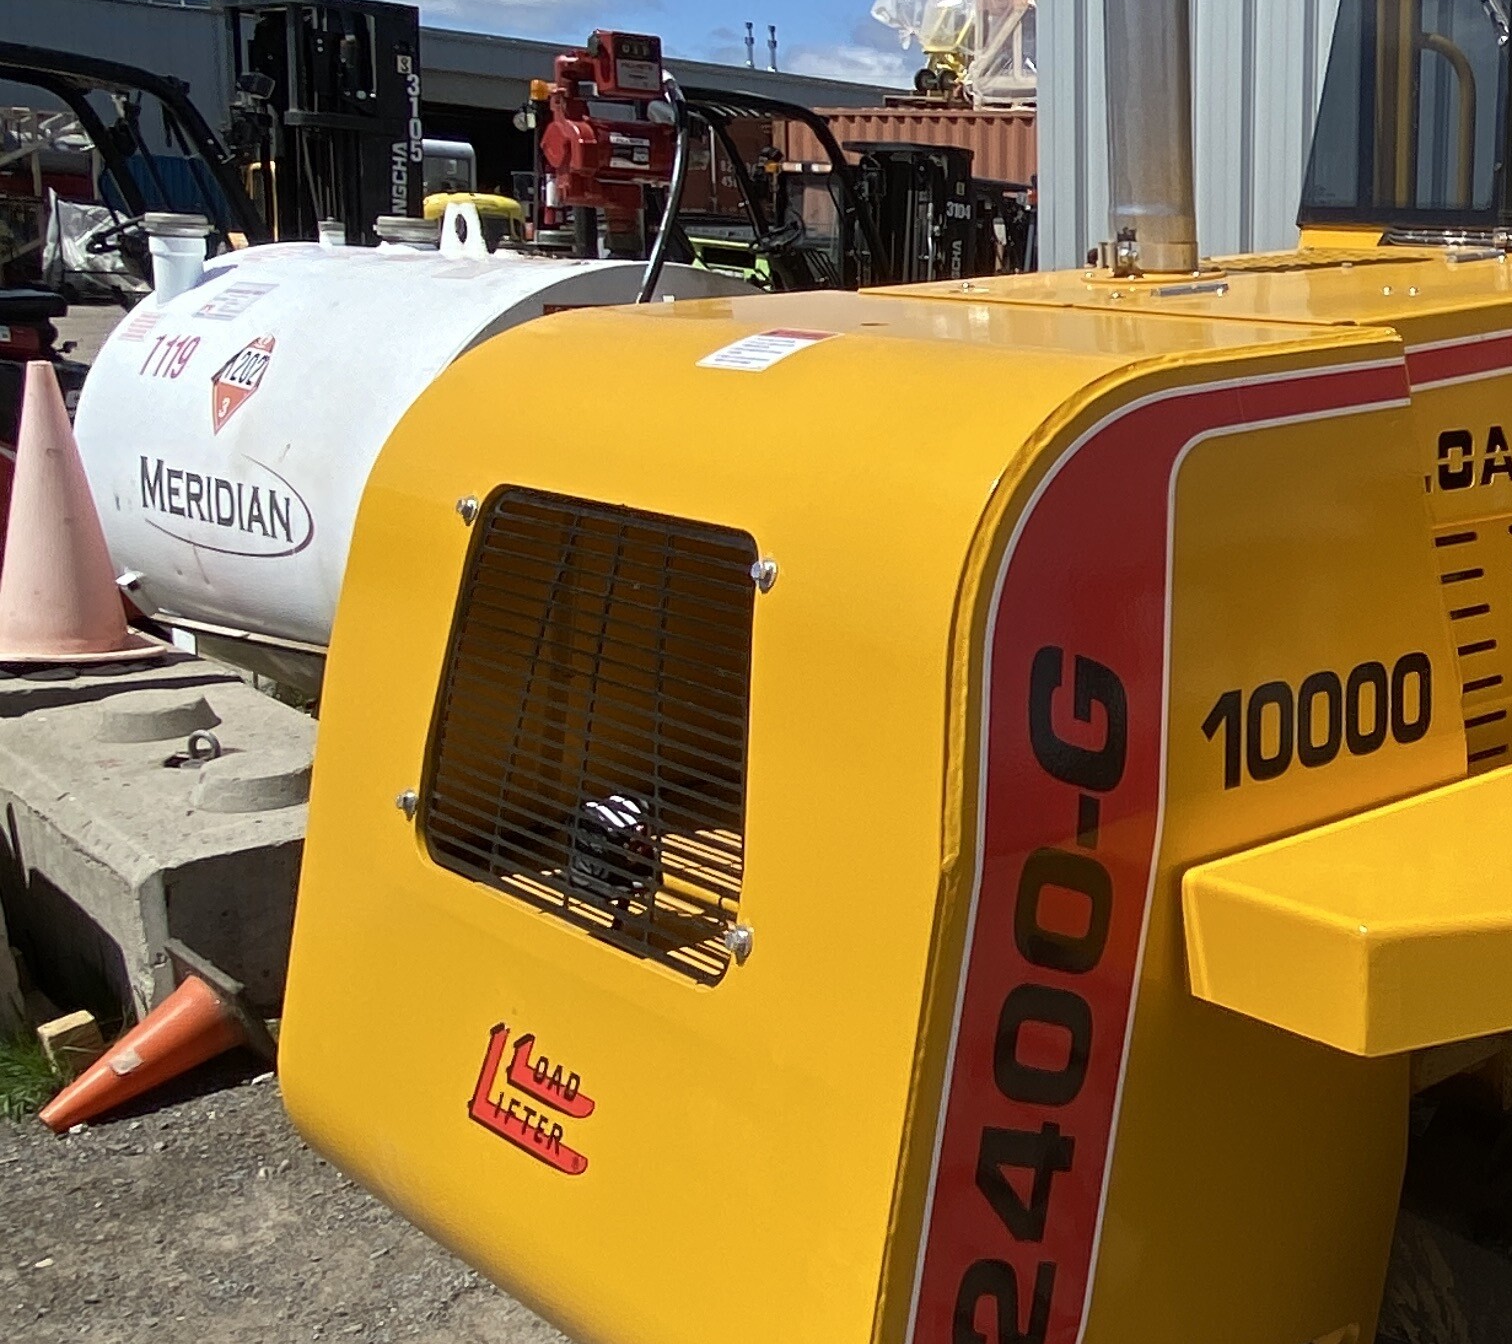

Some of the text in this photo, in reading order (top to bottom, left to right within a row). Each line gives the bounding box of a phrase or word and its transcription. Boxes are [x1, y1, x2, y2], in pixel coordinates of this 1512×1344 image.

[405, 73, 423, 163] 3105
[391, 141, 408, 216] NGCHA
[139, 333, 201, 380] 1119
[218, 396, 231, 418] 3
[139, 455, 294, 544] MERIDIAN
[1201, 652, 1433, 790] 10000
